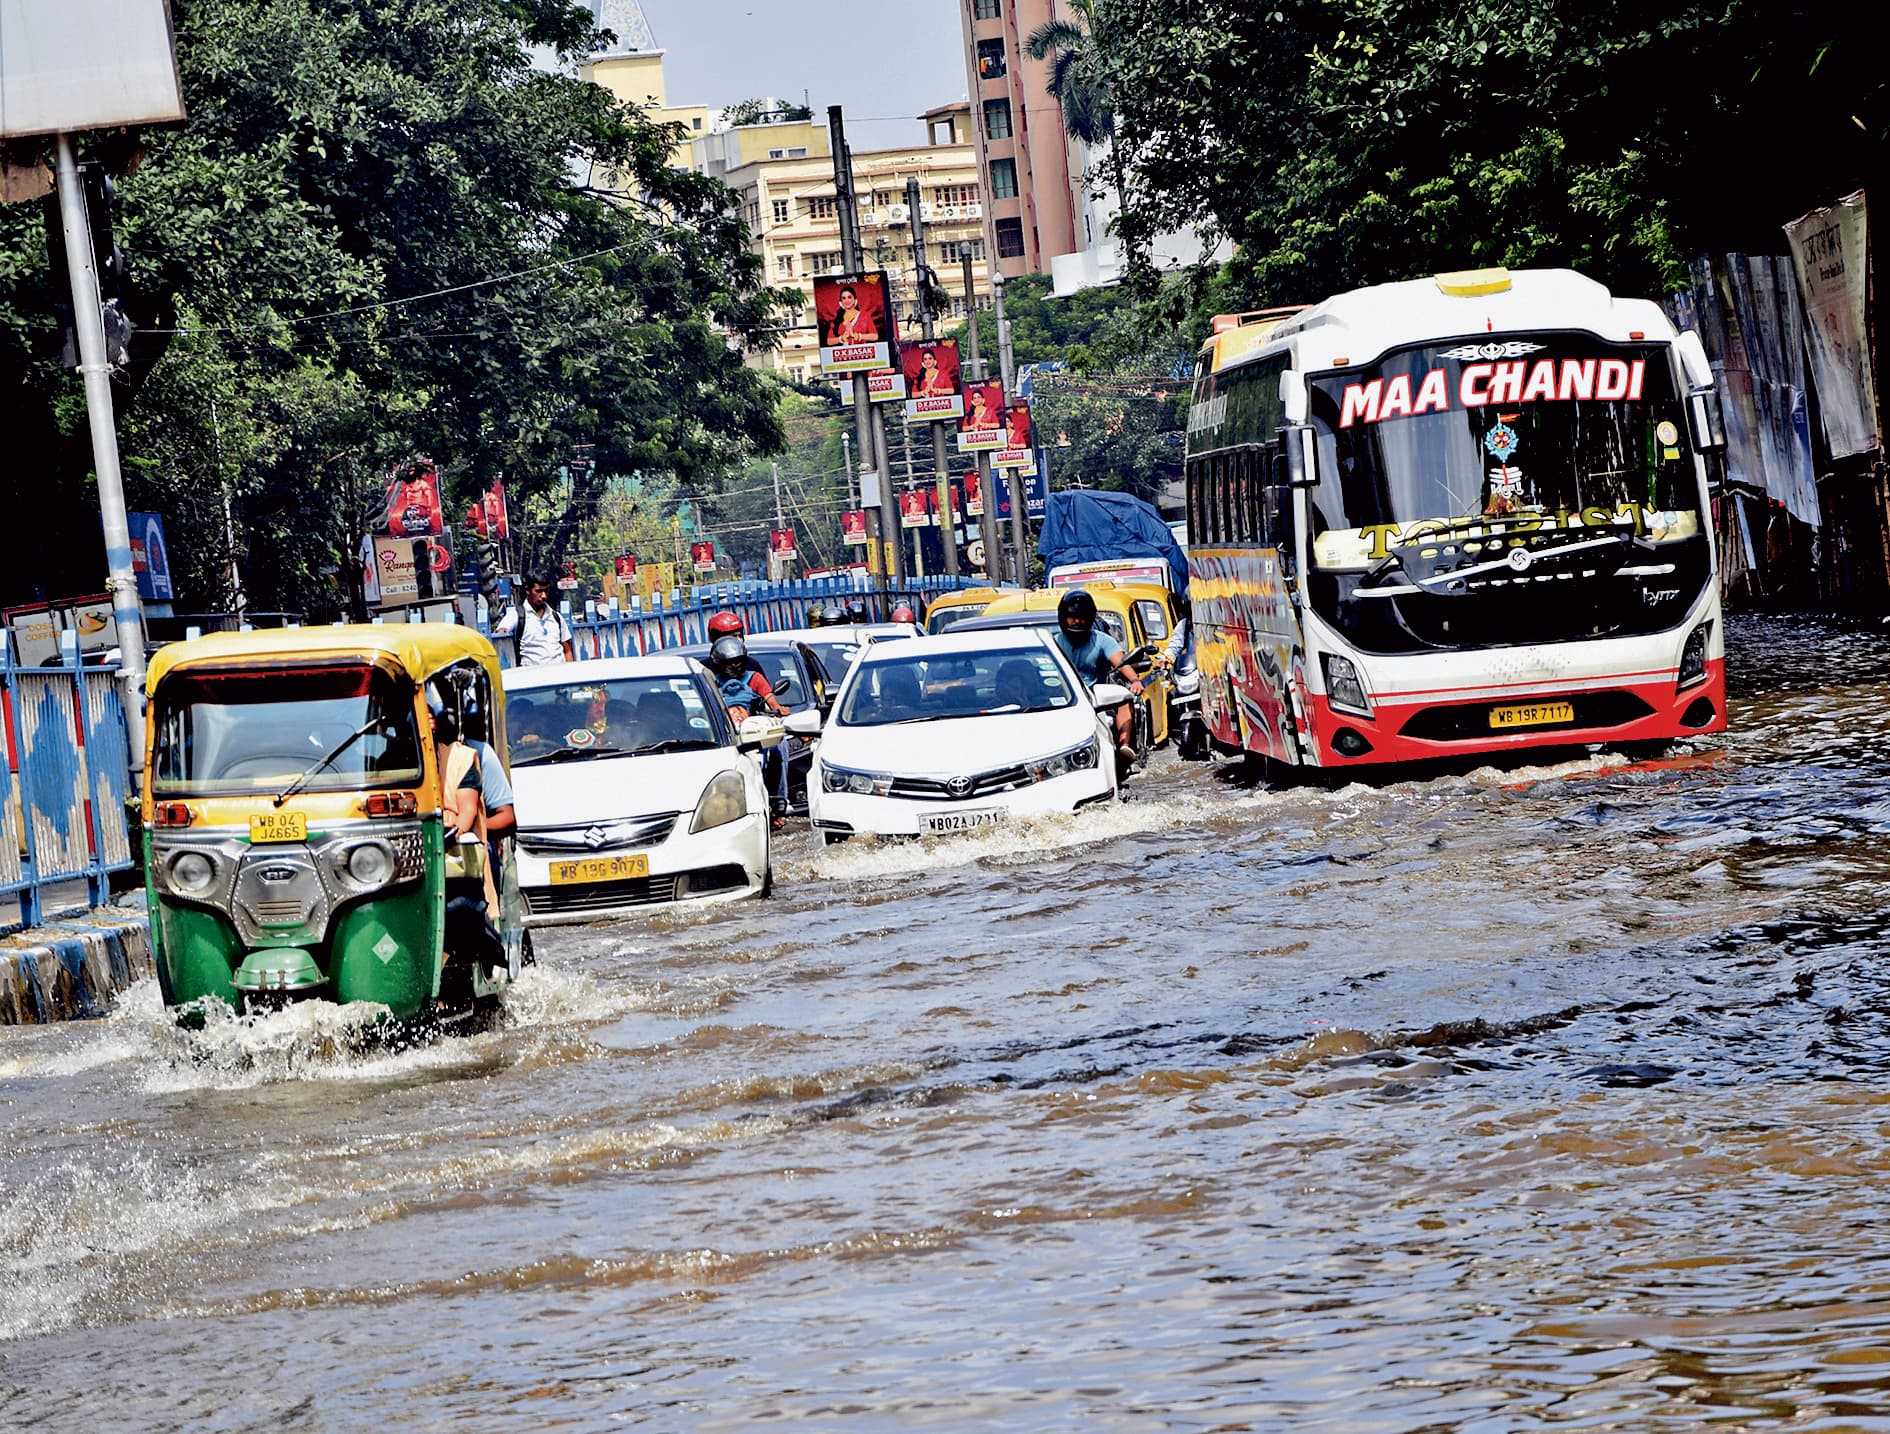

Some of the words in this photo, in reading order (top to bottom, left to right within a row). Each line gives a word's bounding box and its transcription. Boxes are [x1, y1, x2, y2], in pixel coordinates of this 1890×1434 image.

[1340, 367, 1449, 428] MAA
[1459, 359, 1645, 408] CHANDI
[1499, 710, 1513, 722] WB
[1541, 705, 1570, 719] 7117
[260, 815, 275, 827] WB
[280, 815, 296, 826] 04
[261, 827, 300, 839] J4665
